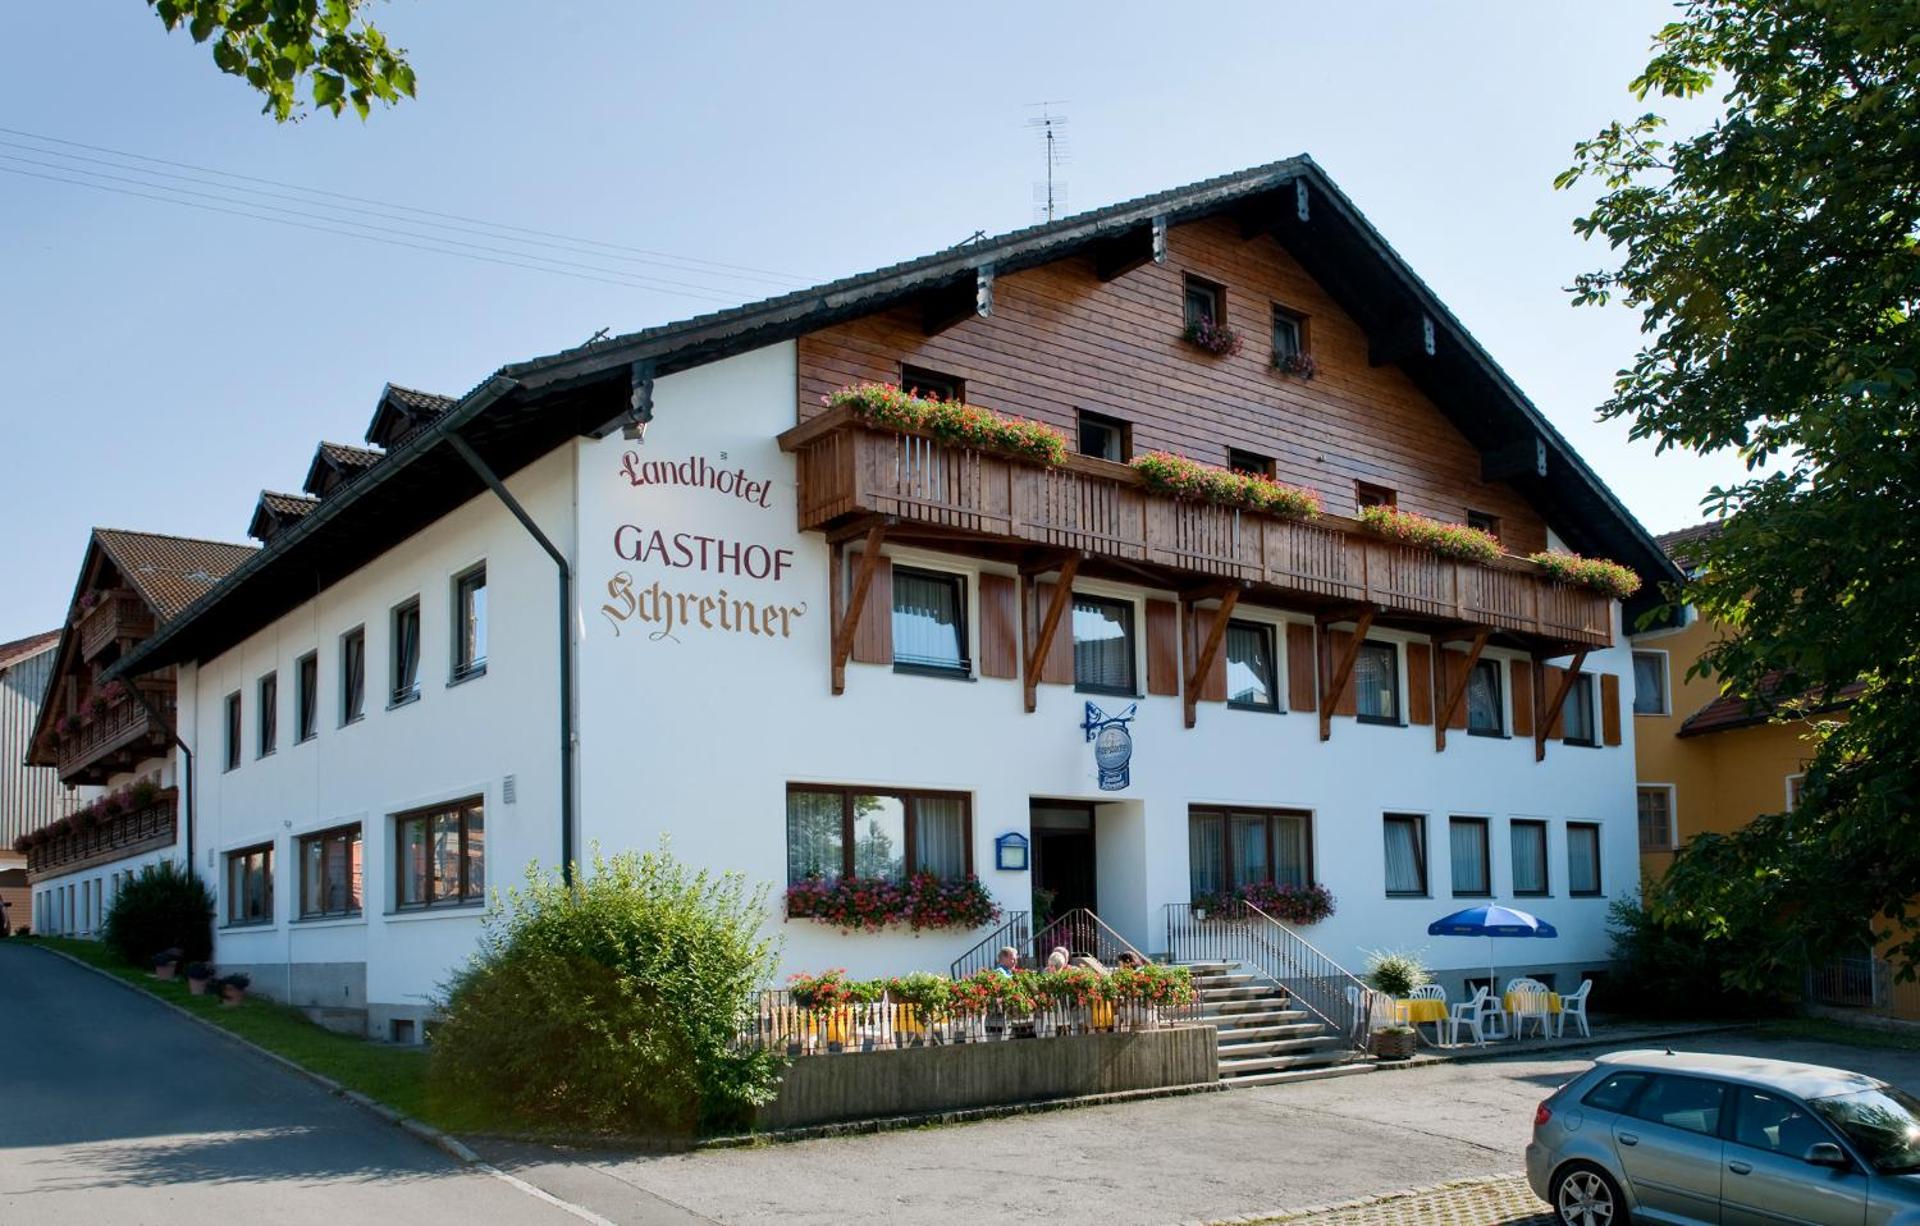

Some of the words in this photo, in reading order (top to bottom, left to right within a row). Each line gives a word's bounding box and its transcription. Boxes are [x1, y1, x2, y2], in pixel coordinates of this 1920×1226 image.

[620, 450, 772, 508] Landhotel
[614, 524, 794, 581] GASTHOF
[601, 571, 807, 643] Schreiner
